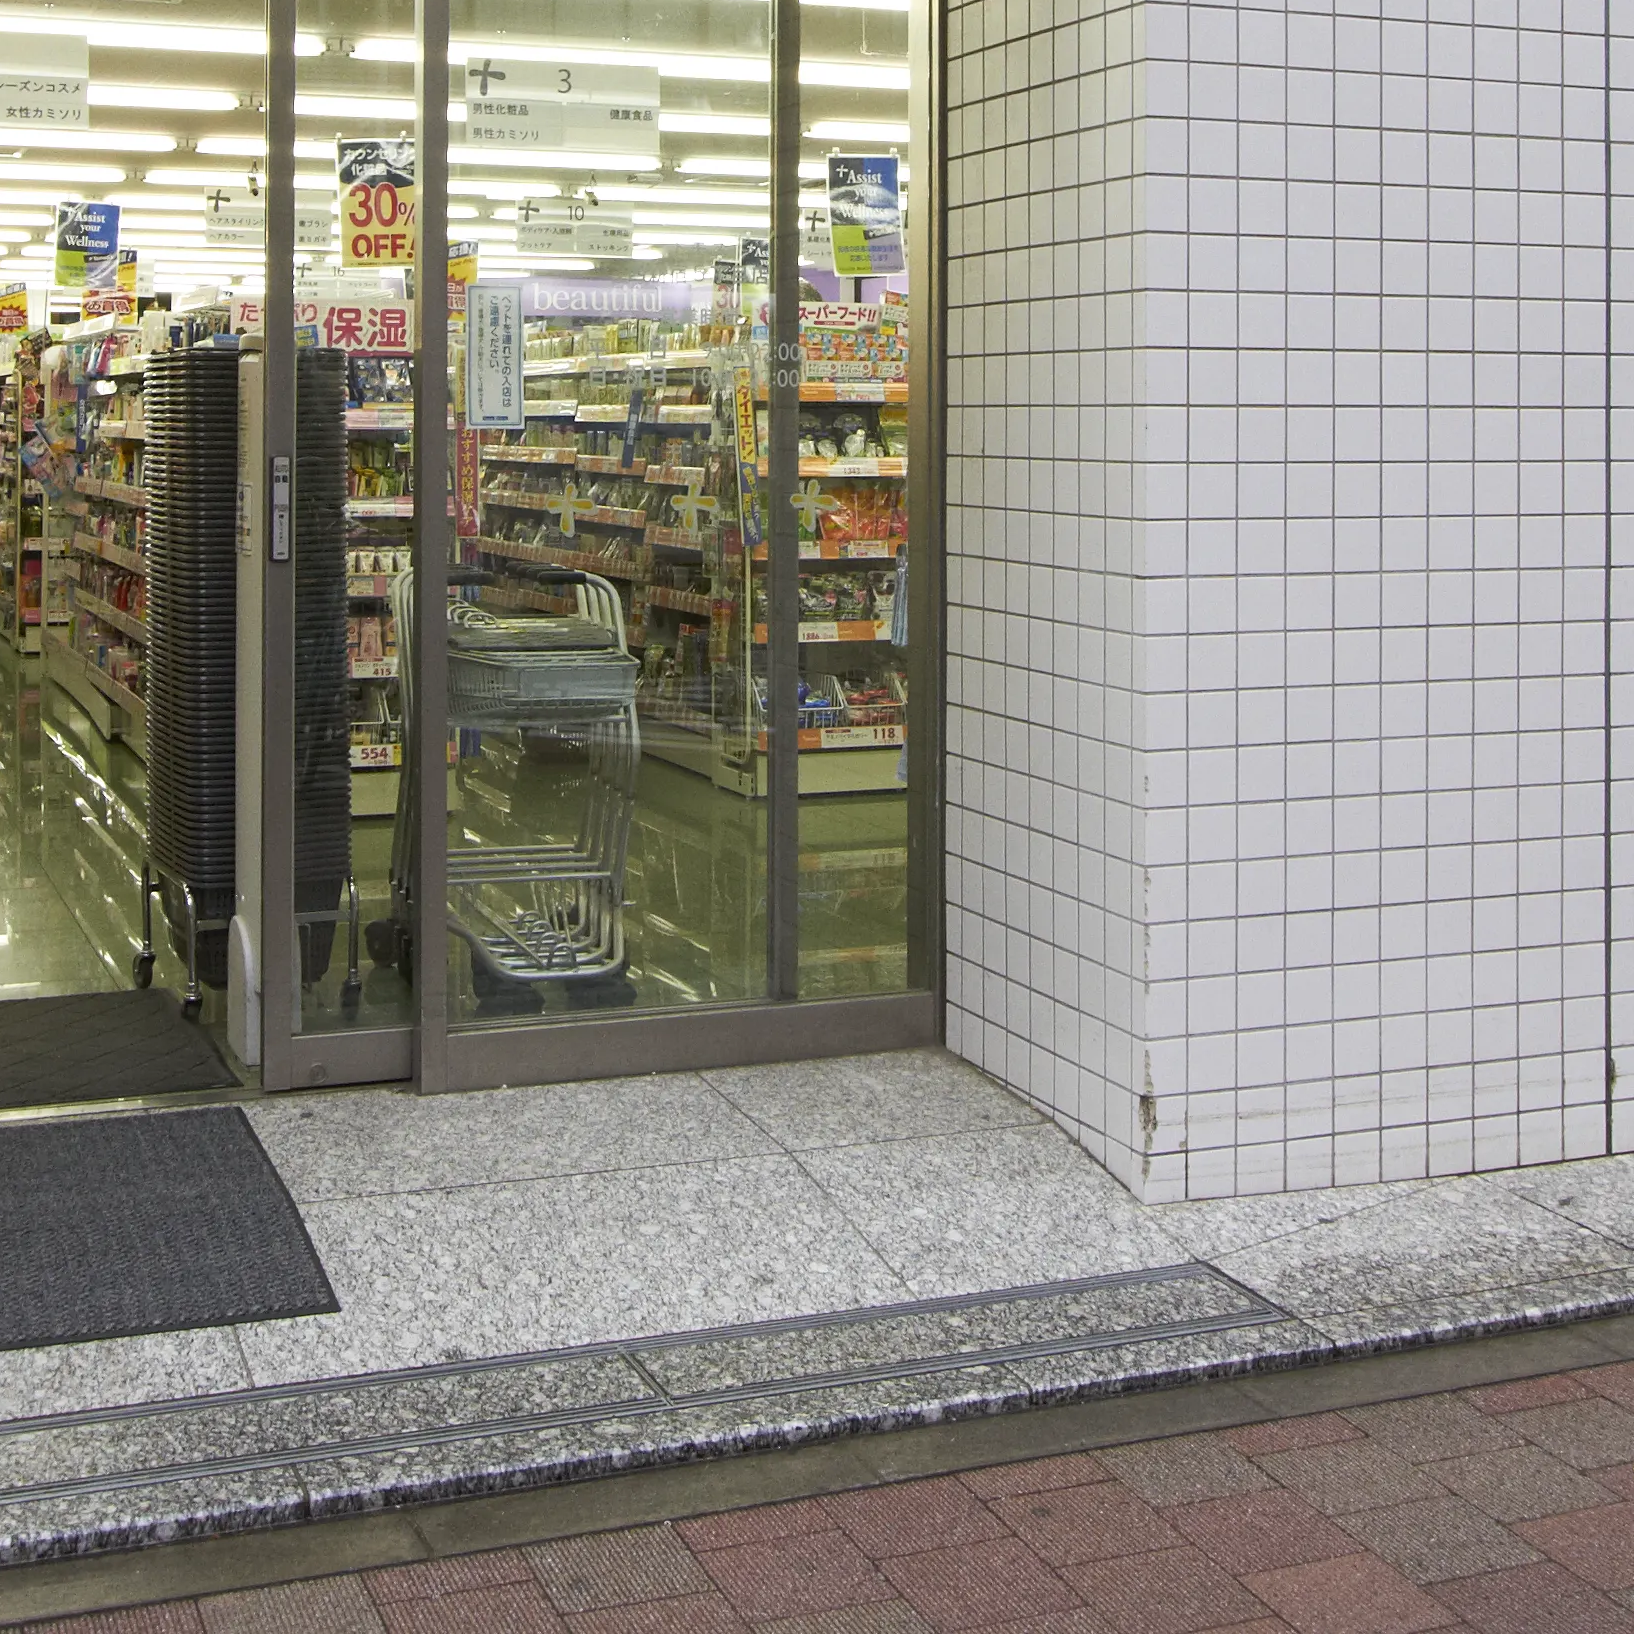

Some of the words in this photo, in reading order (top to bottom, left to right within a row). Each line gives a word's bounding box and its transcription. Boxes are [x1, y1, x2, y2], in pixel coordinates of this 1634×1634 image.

[557, 68, 572, 93] 3
[6, 105, 81, 120] 女性カミソリ
[472, 103, 529, 116] 男性化粧品
[609, 108, 653, 121] 健康食品
[472, 127, 539, 141] 男性カミソリ
[847, 169, 883, 184] Assist
[74, 211, 106, 224] Assist
[568, 205, 585, 221] 10
[80, 223, 102, 234] your
[65, 235, 110, 249] Wellness
[533, 281, 663, 312] beautiful
[322, 306, 407, 349] 保湿
[873, 727, 896, 739] 118
[361, 747, 389, 760] 554
